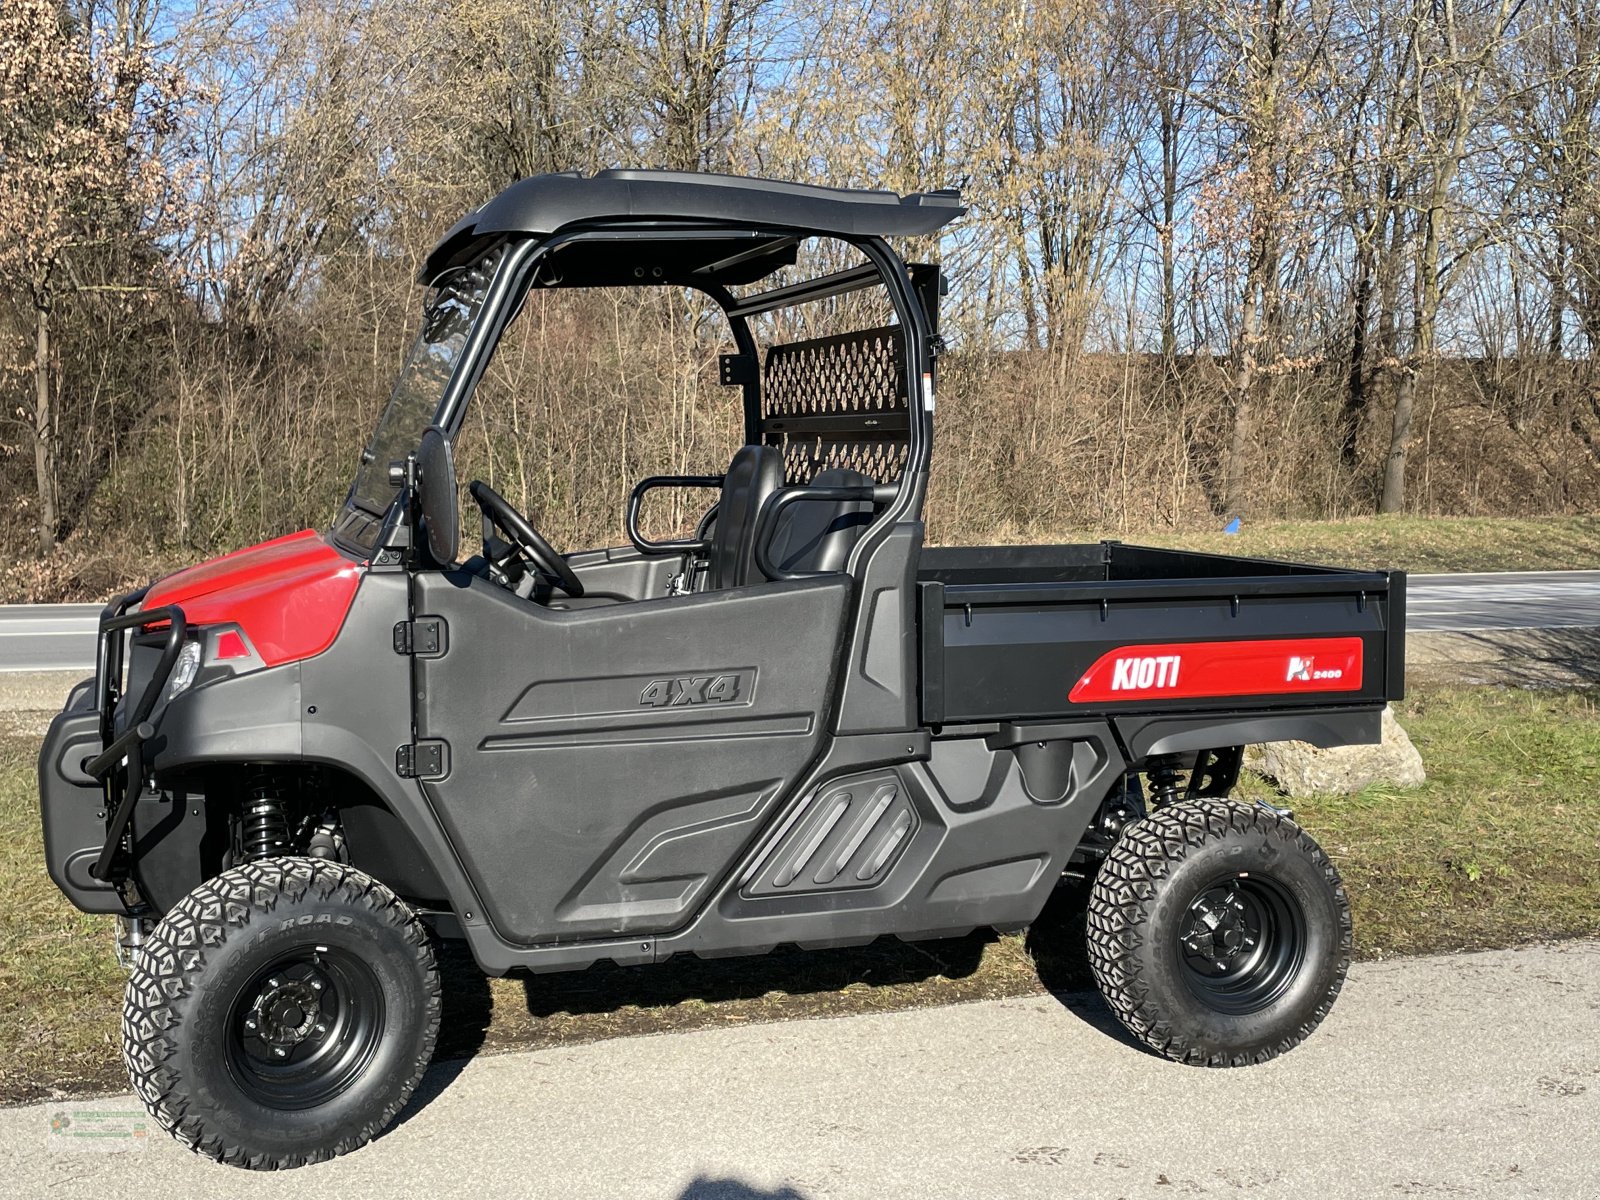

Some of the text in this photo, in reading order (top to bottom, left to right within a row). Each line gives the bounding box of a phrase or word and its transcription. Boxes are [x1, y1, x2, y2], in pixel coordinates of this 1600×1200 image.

[1111, 655, 1181, 690] KIOTI
[1313, 669, 1342, 680] 2400
[639, 675, 740, 707] 4X4
[279, 913, 354, 932] ROAD
